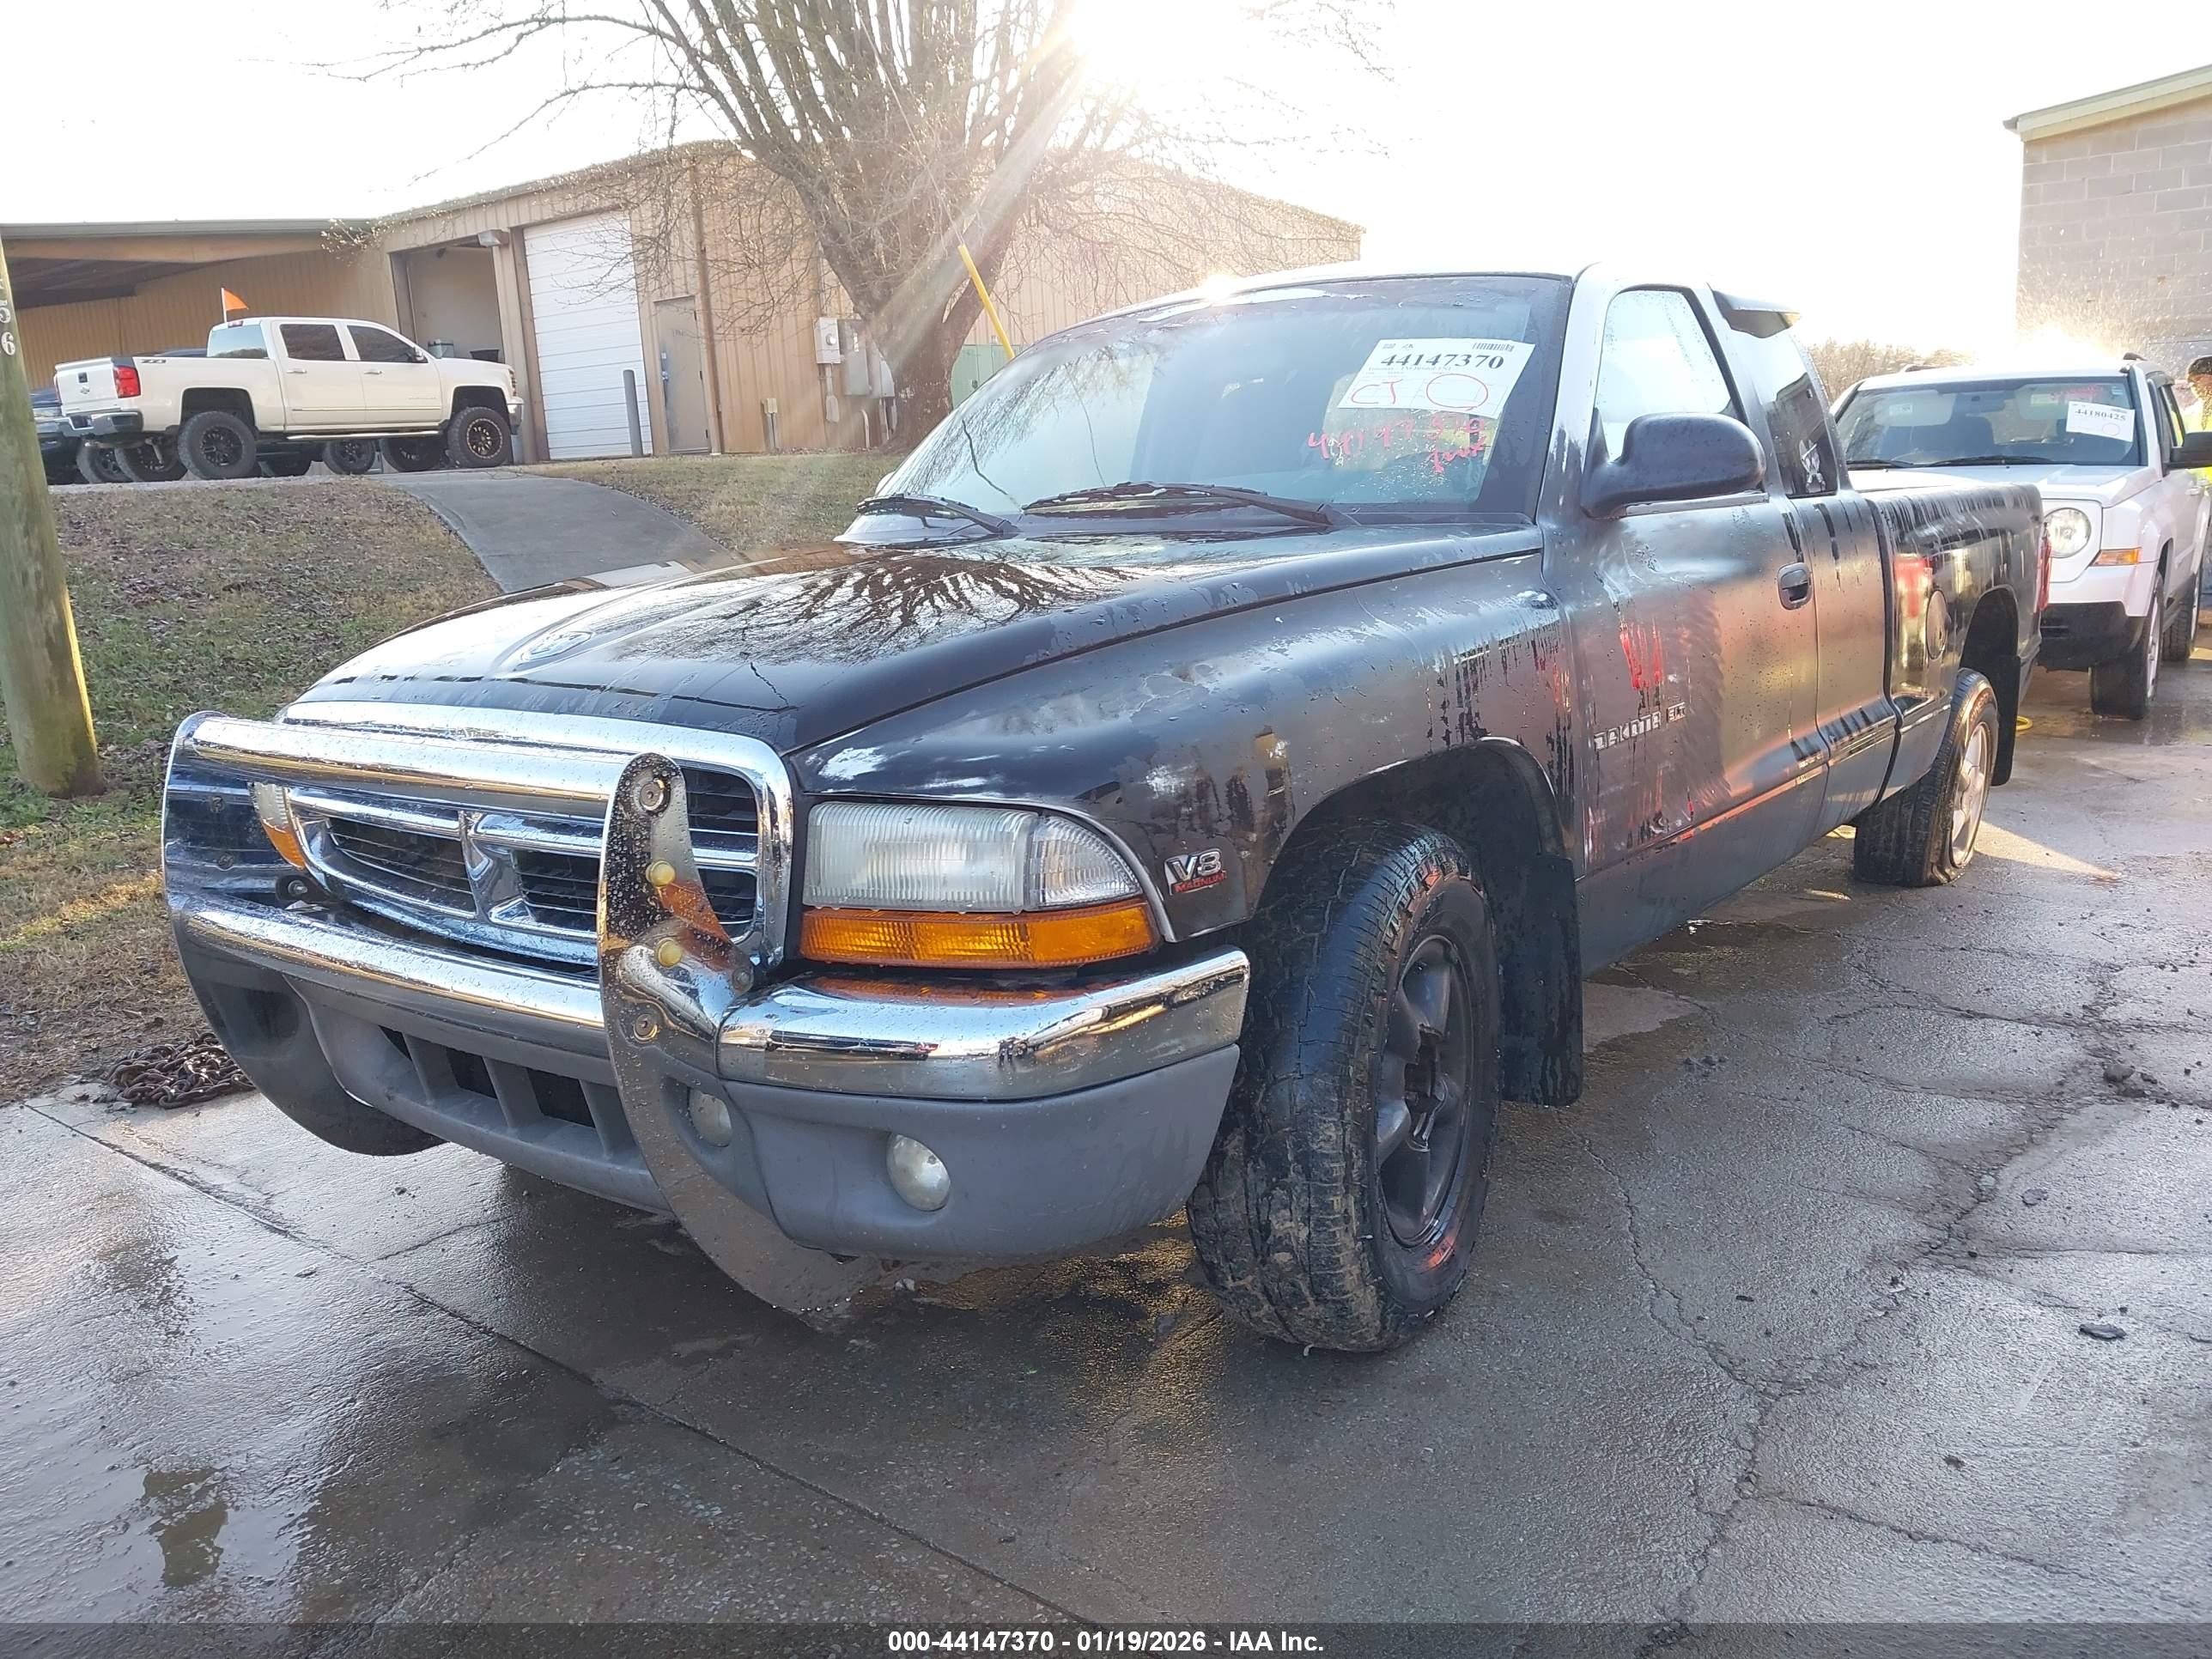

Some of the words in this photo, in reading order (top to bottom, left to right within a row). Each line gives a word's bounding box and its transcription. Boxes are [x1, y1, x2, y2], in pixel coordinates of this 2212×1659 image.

[1381, 353, 1504, 369] 44147370
[2075, 408, 2127, 421] 44180425
[1594, 711, 1662, 750] DAKOTA
[1169, 849, 1221, 882] V8
[1173, 872, 1226, 893] MAGNUM
